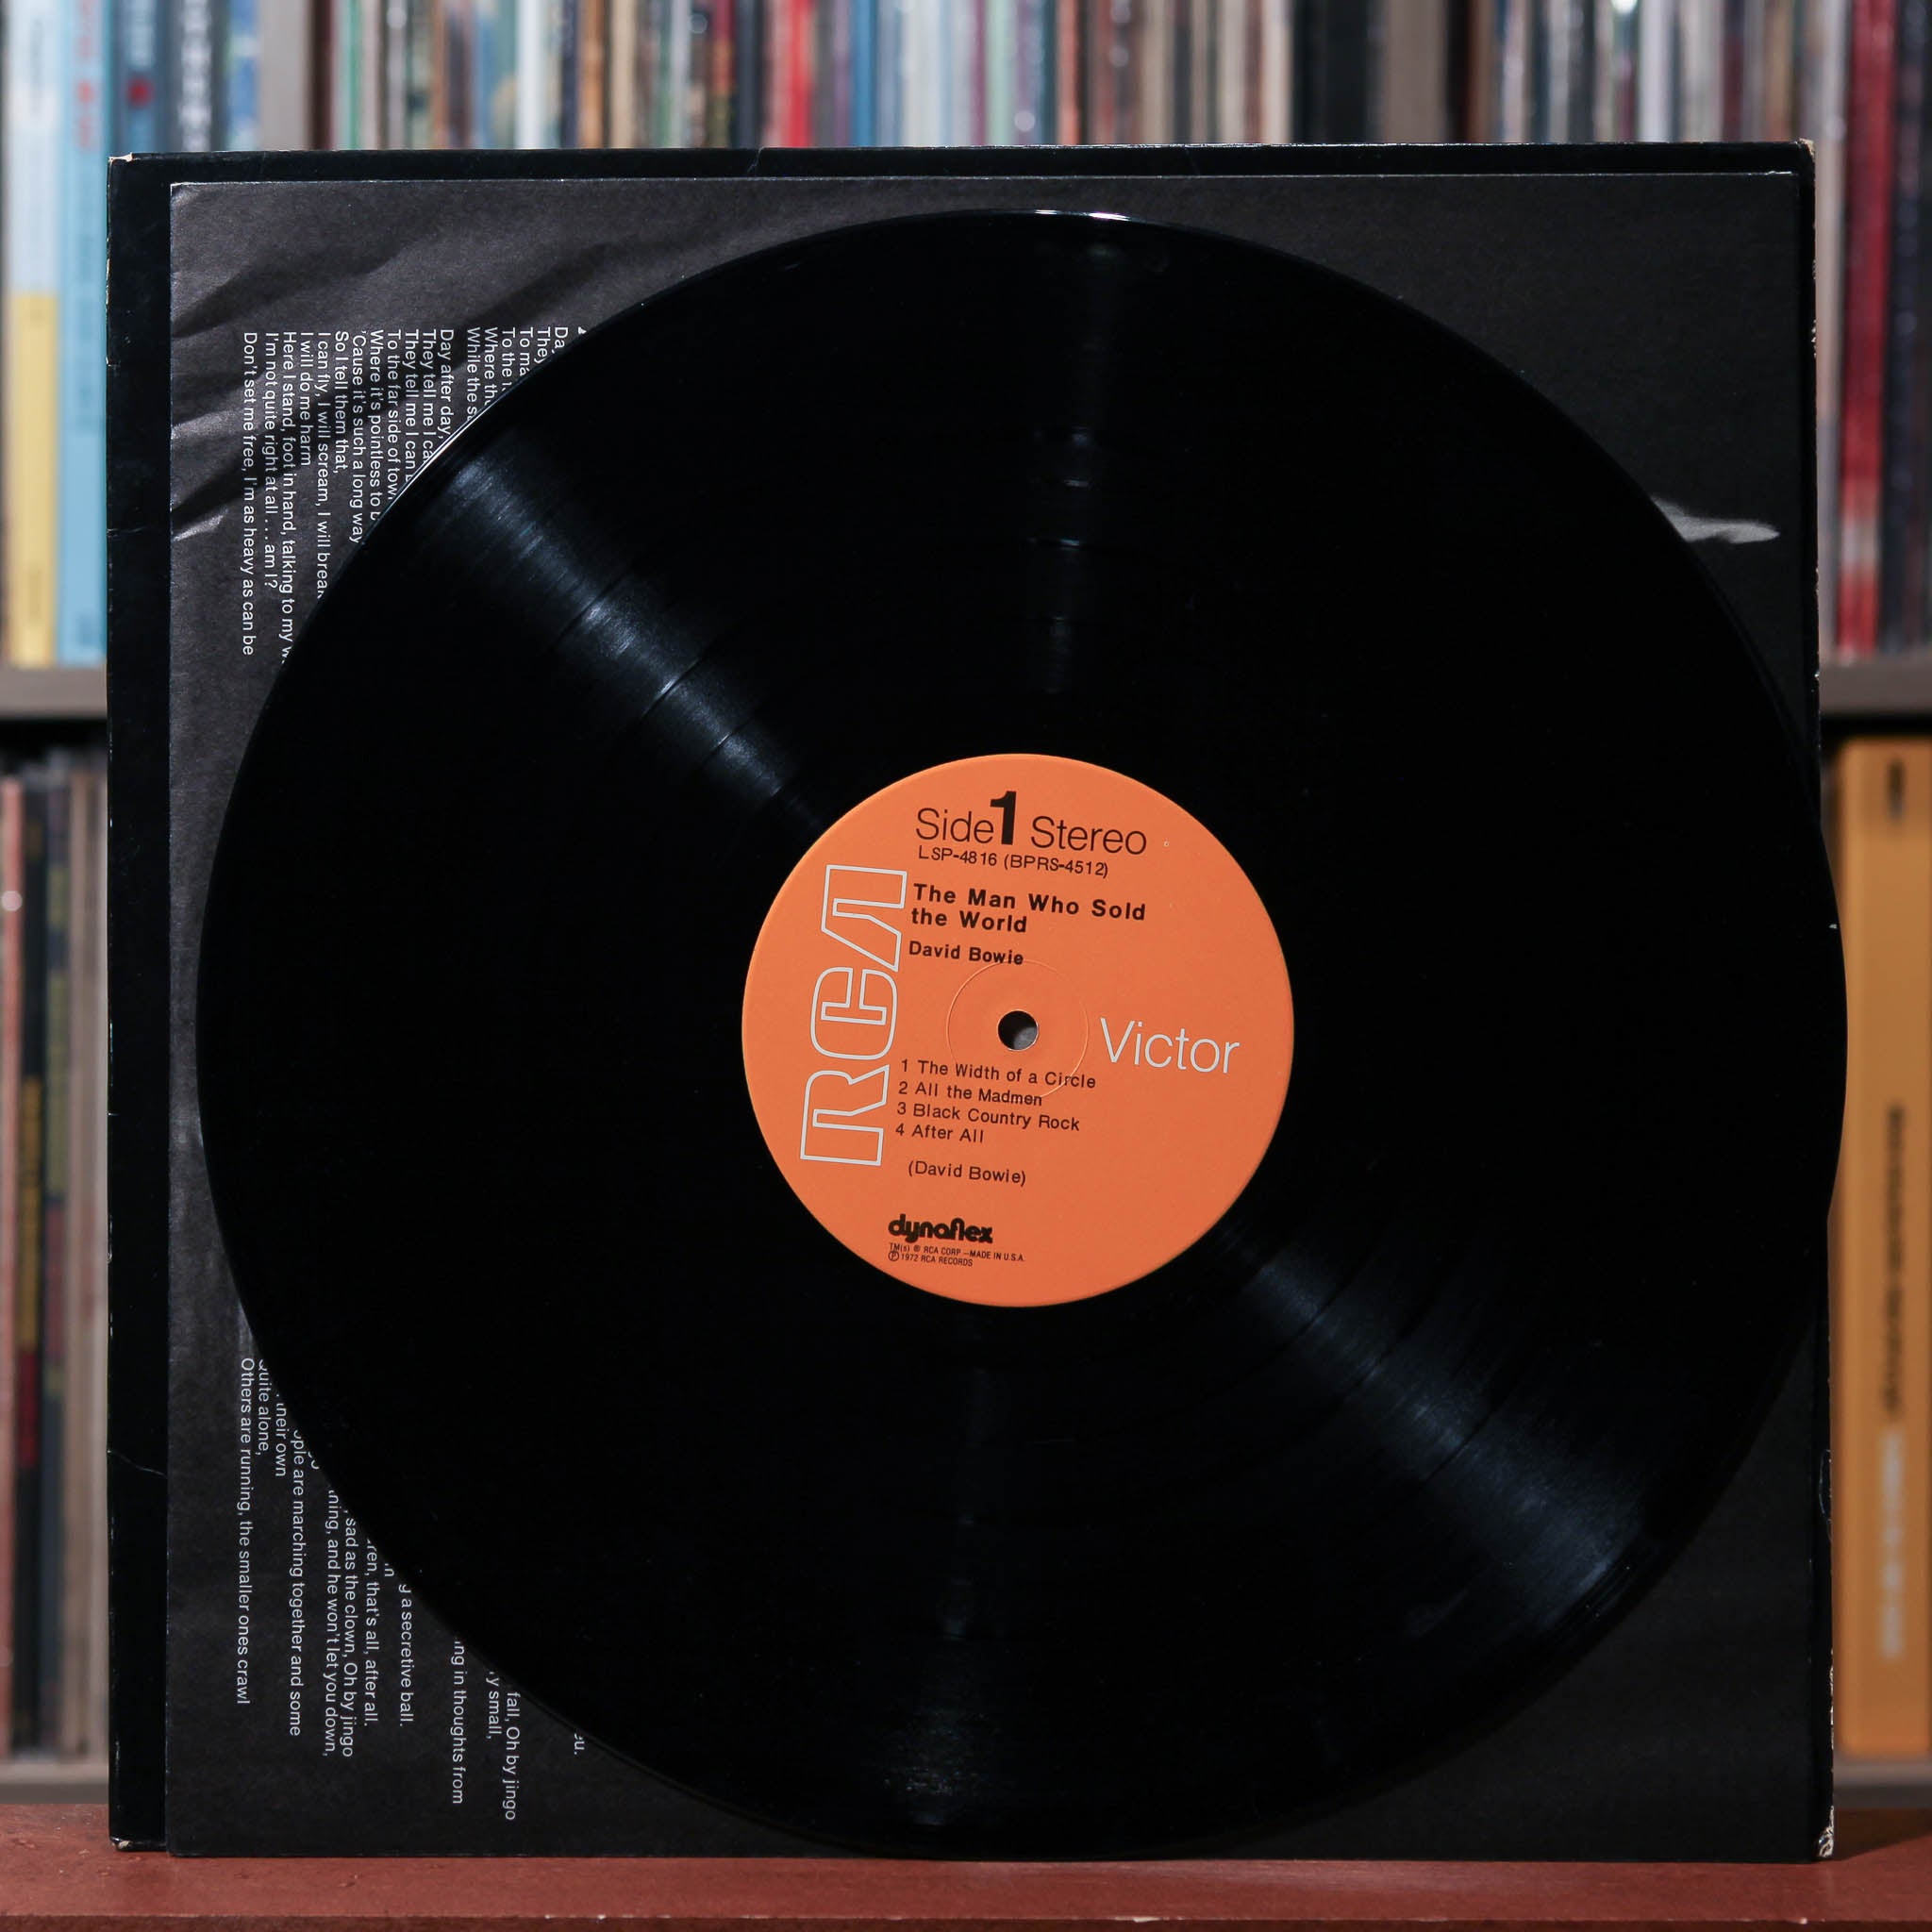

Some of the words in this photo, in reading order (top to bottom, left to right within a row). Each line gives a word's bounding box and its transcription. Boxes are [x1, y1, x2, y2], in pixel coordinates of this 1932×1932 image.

[266, 333, 279, 356] I'm
[283, 332, 297, 370] Here
[335, 331, 349, 352] So
[388, 329, 401, 350] To
[402, 329, 419, 369] They
[438, 329, 454, 360] Day
[244, 333, 258, 375] Don't
[301, 341, 314, 367] will
[318, 341, 328, 369] can
[370, 329, 384, 382] Where
[388, 355, 400, 379] the
[265, 361, 277, 386] not
[300, 372, 313, 391] do
[314, 374, 331, 396] fly,
[335, 366, 348, 389] tell
[406, 374, 419, 397] tell
[441, 365, 454, 402] after
[244, 379, 257, 403] set
[353, 391, 366, 413] it's
[371, 388, 384, 410] it's
[388, 385, 401, 406] far
[243, 408, 254, 430] me
[262, 391, 276, 429] quite
[280, 383, 295, 431] stand,
[300, 396, 310, 420] me
[335, 394, 348, 434] them
[406, 403, 416, 426] me
[318, 411, 330, 438] will
[353, 418, 366, 456] such
[388, 410, 401, 443] side
[437, 407, 455, 440] day,
[242, 435, 257, 471] free,
[262, 435, 278, 472] right
[283, 437, 296, 468] foot
[300, 425, 313, 465] harm
[333, 439, 349, 473] that,
[368, 415, 384, 487] pointless
[388, 448, 401, 463] of
[405, 441, 415, 469] can
[315, 443, 328, 506] scream,
[353, 460, 363, 470] a
[244, 478, 257, 500] I'm
[265, 476, 278, 491] at
[283, 474, 297, 486] in
[349, 475, 366, 508] long
[265, 496, 278, 513] all
[280, 491, 296, 535] hand,
[370, 491, 383, 507] to
[243, 506, 254, 524] as
[349, 513, 362, 542] way
[317, 521, 330, 547] will
[241, 528, 257, 575] heavy
[265, 544, 275, 568] am
[279, 540, 296, 593] talking
[242, 579, 253, 597] as
[264, 575, 278, 588] I?
[242, 602, 253, 630] can
[282, 598, 294, 613] to
[279, 619, 292, 641] my
[242, 636, 257, 655] be
[916, 808, 993, 843] Side
[991, 791, 1017, 845] 1
[1031, 815, 1147, 855] Stereo
[919, 845, 996, 866] LSP-4816
[1004, 855, 1108, 878] (BPRS-4512)
[913, 883, 956, 904] The
[968, 889, 1015, 909] Man
[1028, 893, 1079, 915] Who
[1091, 900, 1145, 921] Sold
[911, 908, 947, 926] the
[959, 911, 1027, 932] World
[909, 941, 960, 960] David
[968, 947, 1024, 964] Bowie
[800, 864, 908, 1167] RCA
[1100, 1017, 1240, 1074] Victor
[902, 1058, 908, 1072] 1
[917, 1060, 948, 1075] The
[956, 1064, 1000, 1080] Width
[1007, 1069, 1022, 1081] of
[1028, 1074, 1038, 1083] a
[1045, 1072, 1096, 1089] Circle
[898, 1081, 908, 1094] 2
[915, 1082, 938, 1096] All
[947, 1085, 972, 1099] the
[978, 1091, 1041, 1106] Madmen
[897, 1102, 907, 1115] 3
[913, 1104, 960, 1120] Black
[968, 1108, 1031, 1129] Country
[1038, 1115, 1079, 1130] Rock
[896, 1124, 905, 1136] 4
[911, 1124, 953, 1140] After
[959, 1128, 983, 1143] All
[908, 1160, 962, 1177] (David
[969, 1166, 1026, 1187] Bowie)
[888, 1213, 992, 1243] dynaflex
[921, 1255, 936, 1263] RCA
[939, 1257, 974, 1267] RECORDS
[924, 1245, 938, 1254] RCA
[241, 1358, 255, 1414] Others
[241, 1418, 251, 1442] are
[237, 1450, 254, 1515] running,
[293, 1470, 303, 1495] are
[240, 1521, 253, 1546] the
[290, 1501, 307, 1576] marching
[345, 1518, 358, 1546] sad
[328, 1540, 341, 1569] and
[345, 1552, 356, 1570] as
[239, 1551, 252, 1611] smaller
[327, 1574, 341, 1594] he
[345, 1574, 358, 1600] the
[289, 1582, 305, 1652] together
[366, 1582, 380, 1625] that's
[402, 1599, 411, 1607] a
[238, 1615, 249, 1655] ones
[326, 1599, 340, 1643] won't
[342, 1605, 358, 1657] clown,
[363, 1631, 379, 1654] all,
[401, 1611, 414, 1687] secretive
[291, 1656, 304, 1686] and
[326, 1648, 340, 1668] let
[237, 1660, 250, 1703] crawl
[324, 1673, 337, 1702] you
[344, 1663, 358, 1686] Oh
[365, 1660, 378, 1698] after
[454, 1672, 467, 1684] in
[290, 1691, 300, 1736] some
[341, 1691, 357, 1710] by
[364, 1703, 378, 1725] all.
[400, 1692, 413, 1726] ball.
[505, 1692, 521, 1721] fall,
[323, 1707, 339, 1756] down,
[340, 1716, 357, 1757] jingo
[450, 1690, 467, 1762] thoughts
[507, 1727, 520, 1750] Oh
[503, 1756, 519, 1774] by
[453, 1767, 466, 1803] from
[503, 1779, 519, 1820] jingo
